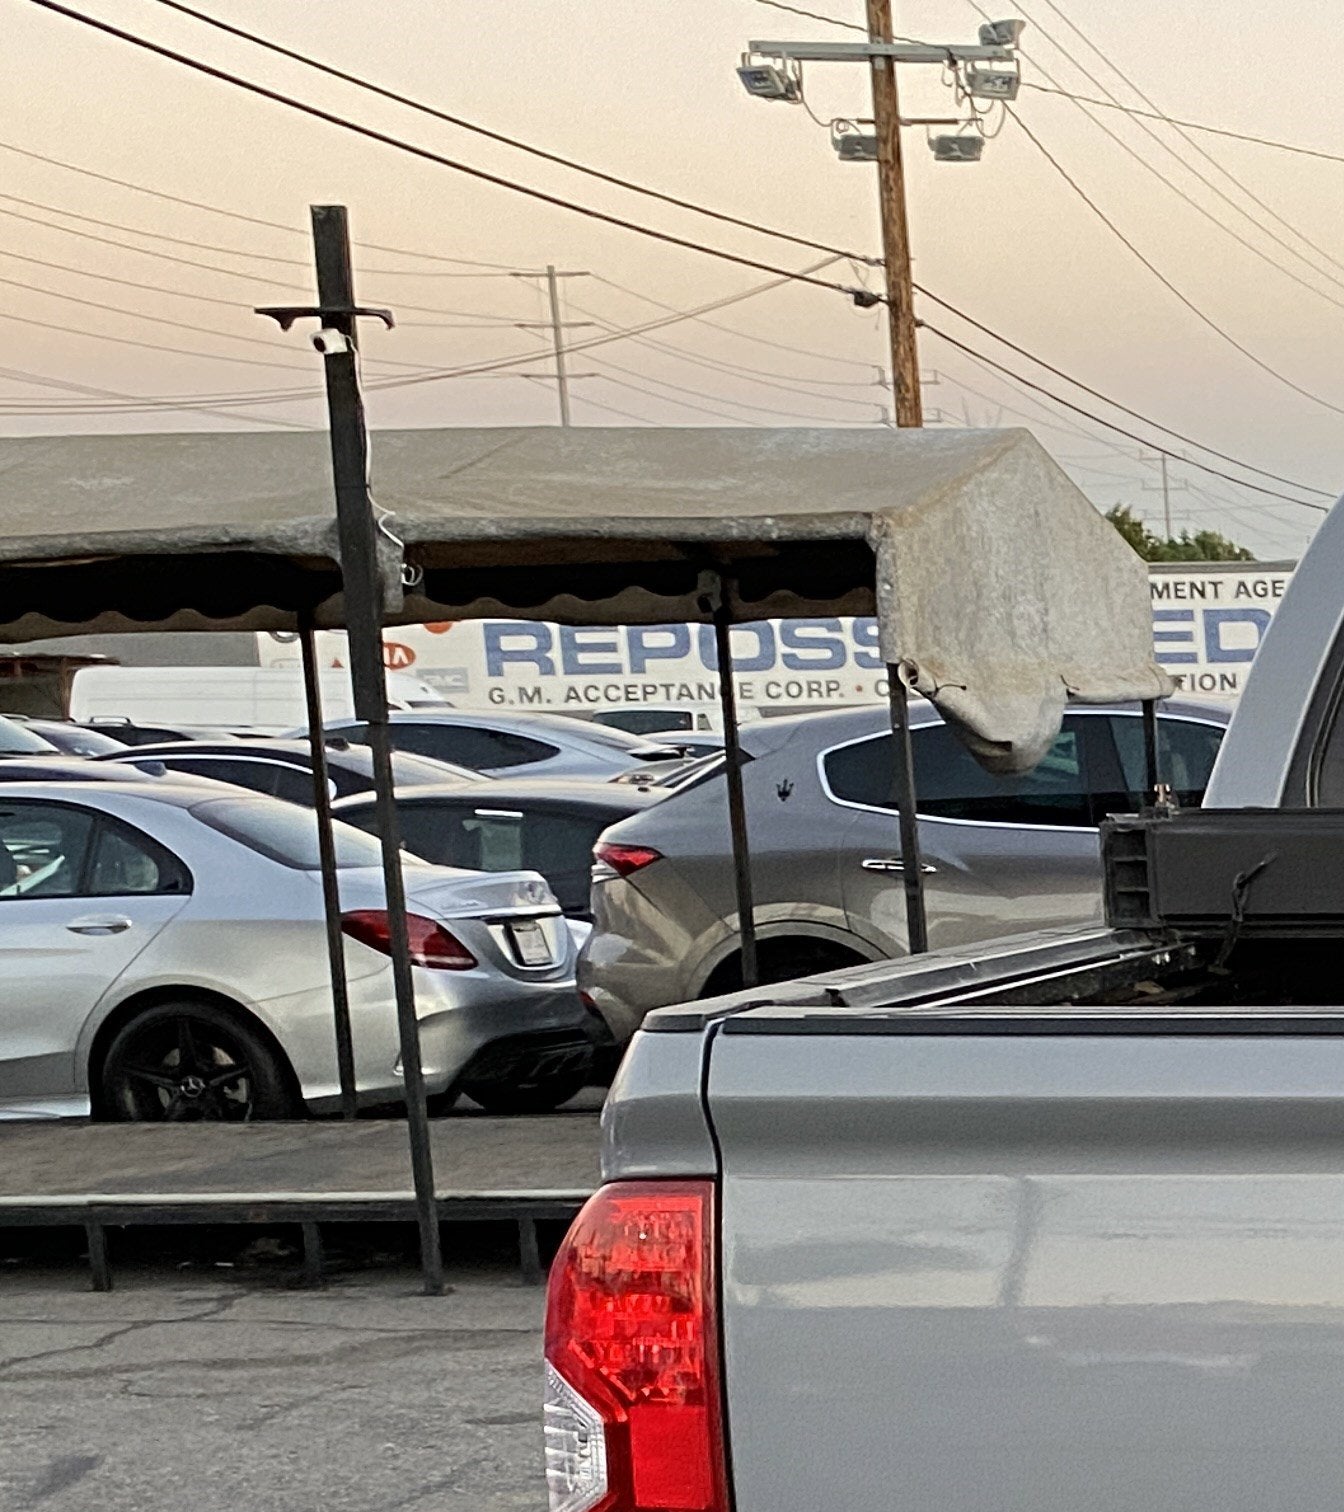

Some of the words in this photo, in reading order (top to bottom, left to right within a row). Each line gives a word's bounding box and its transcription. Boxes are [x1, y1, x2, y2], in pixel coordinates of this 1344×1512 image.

[488, 686, 551, 704] G.M.
[564, 682, 754, 703] ACCEPTANE
[765, 680, 845, 699] CORP.
